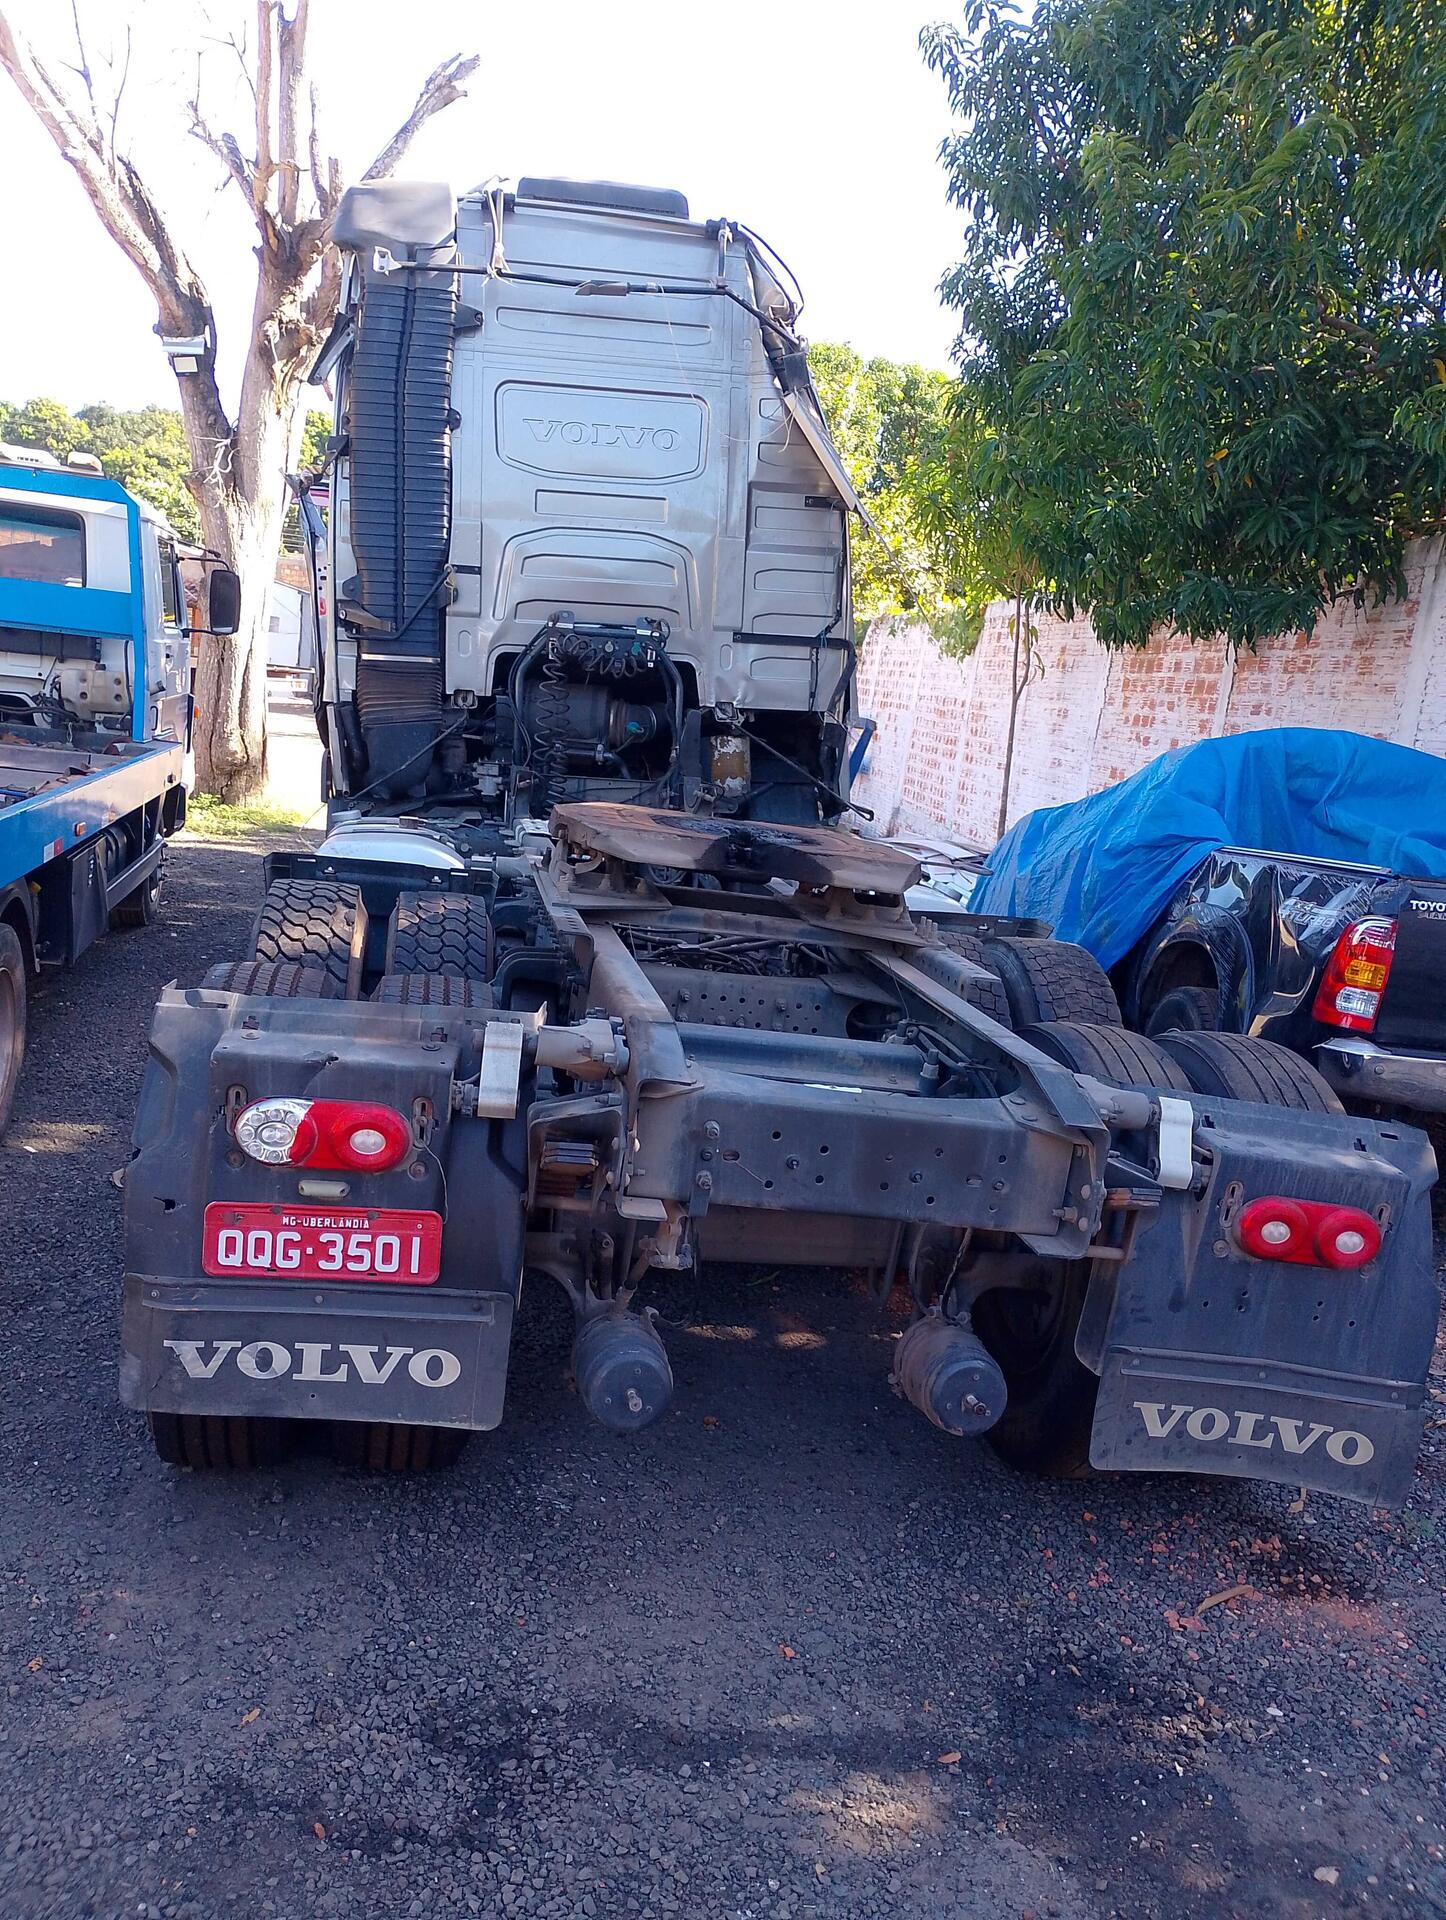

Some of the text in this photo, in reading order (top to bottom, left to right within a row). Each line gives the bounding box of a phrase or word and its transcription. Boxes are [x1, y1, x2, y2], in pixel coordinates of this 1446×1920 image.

[522, 418, 681, 451] VOLVO
[1410, 900, 1446, 912] TOYO
[163, 1339, 461, 1387] VOLVO
[1133, 1401, 1375, 1466] VOLVO
